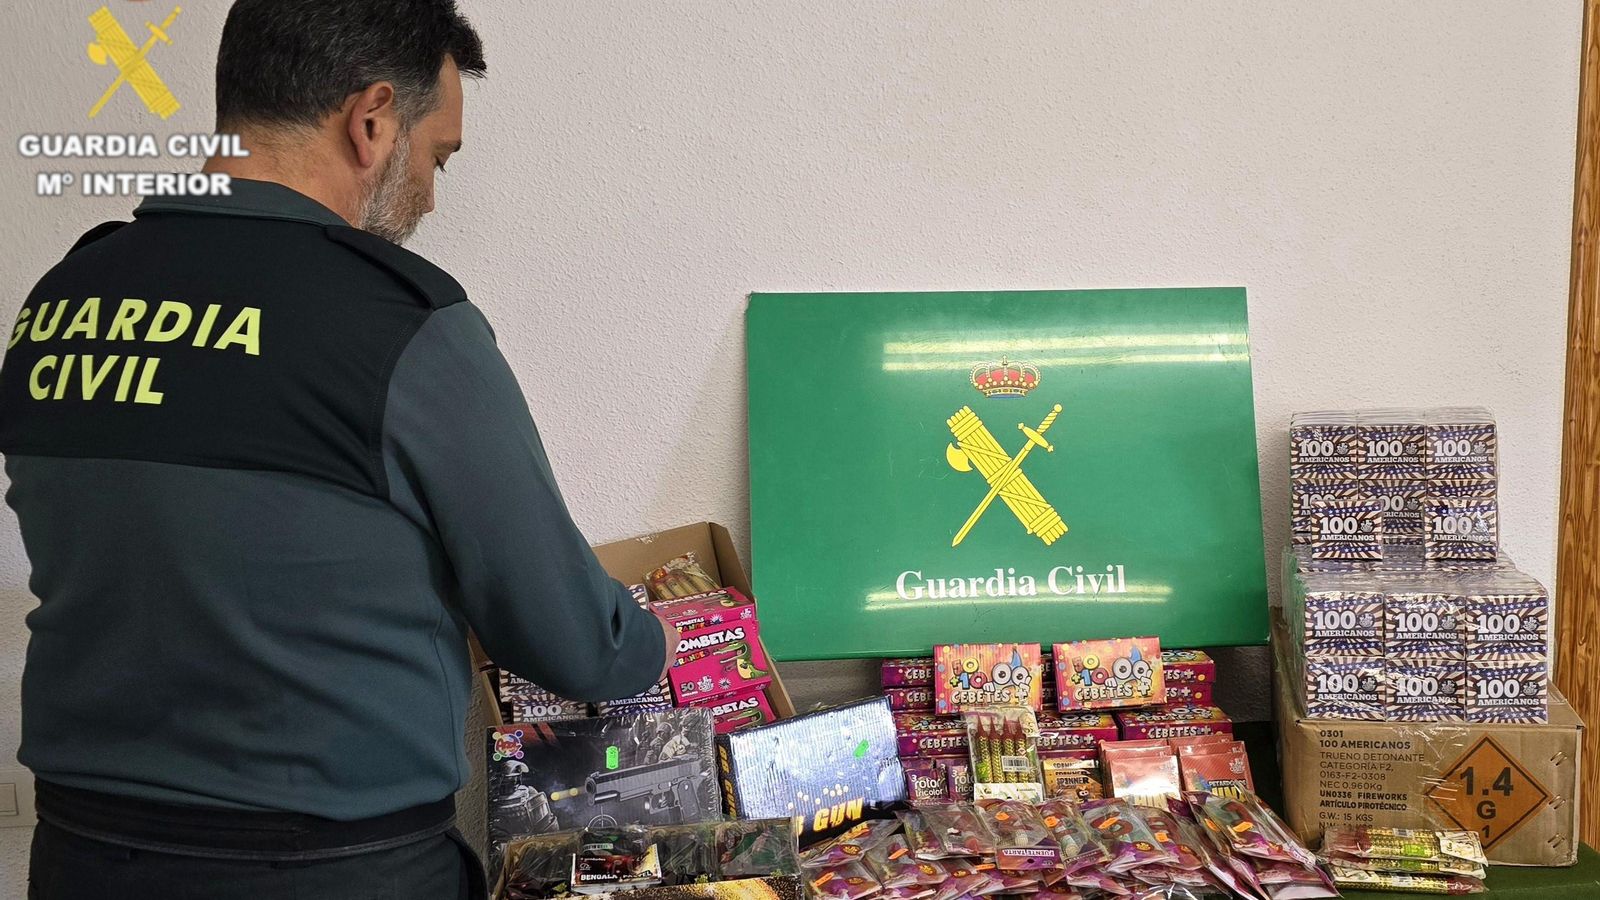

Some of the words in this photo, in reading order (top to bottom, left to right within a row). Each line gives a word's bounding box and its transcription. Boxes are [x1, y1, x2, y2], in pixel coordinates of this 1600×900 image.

[7, 297, 261, 355] GUARDIA
[29, 354, 164, 405] CIVIL
[1299, 440, 1334, 457] 100
[1366, 440, 1402, 457] 100
[1434, 439, 1471, 456] 100
[1321, 517, 1358, 534] 100
[1432, 516, 1472, 534] 100
[895, 568, 1037, 600] Guardia
[1048, 564, 1127, 596] Civil
[1313, 610, 1356, 630] 100
[1395, 612, 1438, 632] 100
[1476, 614, 1520, 634] 100
[1314, 629, 1375, 637] AMERICANOS
[1396, 632, 1457, 640] AMERICANOS
[1477, 633, 1539, 641] AMERICANOS
[676, 627, 746, 653] OMBETAS
[905, 667, 932, 680] CEBE
[680, 681, 695, 692] 50
[1317, 674, 1358, 693] 100
[1396, 677, 1438, 696] 100
[1476, 679, 1520, 699] 100
[609, 696, 664, 706] AMERICANOS
[906, 691, 932, 703] CEBE
[1317, 693, 1377, 701] AMERICANOS
[1396, 696, 1457, 704] AMERICANOS
[1477, 698, 1539, 706] AMERICANOS
[522, 704, 562, 717] 100
[713, 697, 759, 716] BETAS
[1148, 726, 1197, 739] CEBETES
[1320, 730, 1343, 738] 0301
[1037, 734, 1079, 747] EBETES
[1320, 740, 1338, 748] 100
[1340, 740, 1411, 750] AMERICANOS
[1320, 751, 1360, 760] TRUENO
[1363, 752, 1425, 762] DETONANTE
[1320, 761, 1377, 771] CATEGORÍA
[911, 774, 918, 783] 3
[1320, 771, 1386, 780] 0163-F2-0308
[1460, 766, 1513, 796] 1.4
[1320, 790, 1352, 798] UN0336
[1358, 792, 1407, 801] FIREWORKS
[1320, 799, 1356, 808] ARTÍCULO
[1358, 800, 1407, 811] PIROTÉCNICO
[1476, 801, 1496, 820] G
[812, 797, 865, 833] GUN
[1319, 811, 1340, 819] G.W.:
[1481, 825, 1490, 838] 1
[580, 873, 617, 881] BENGALA
